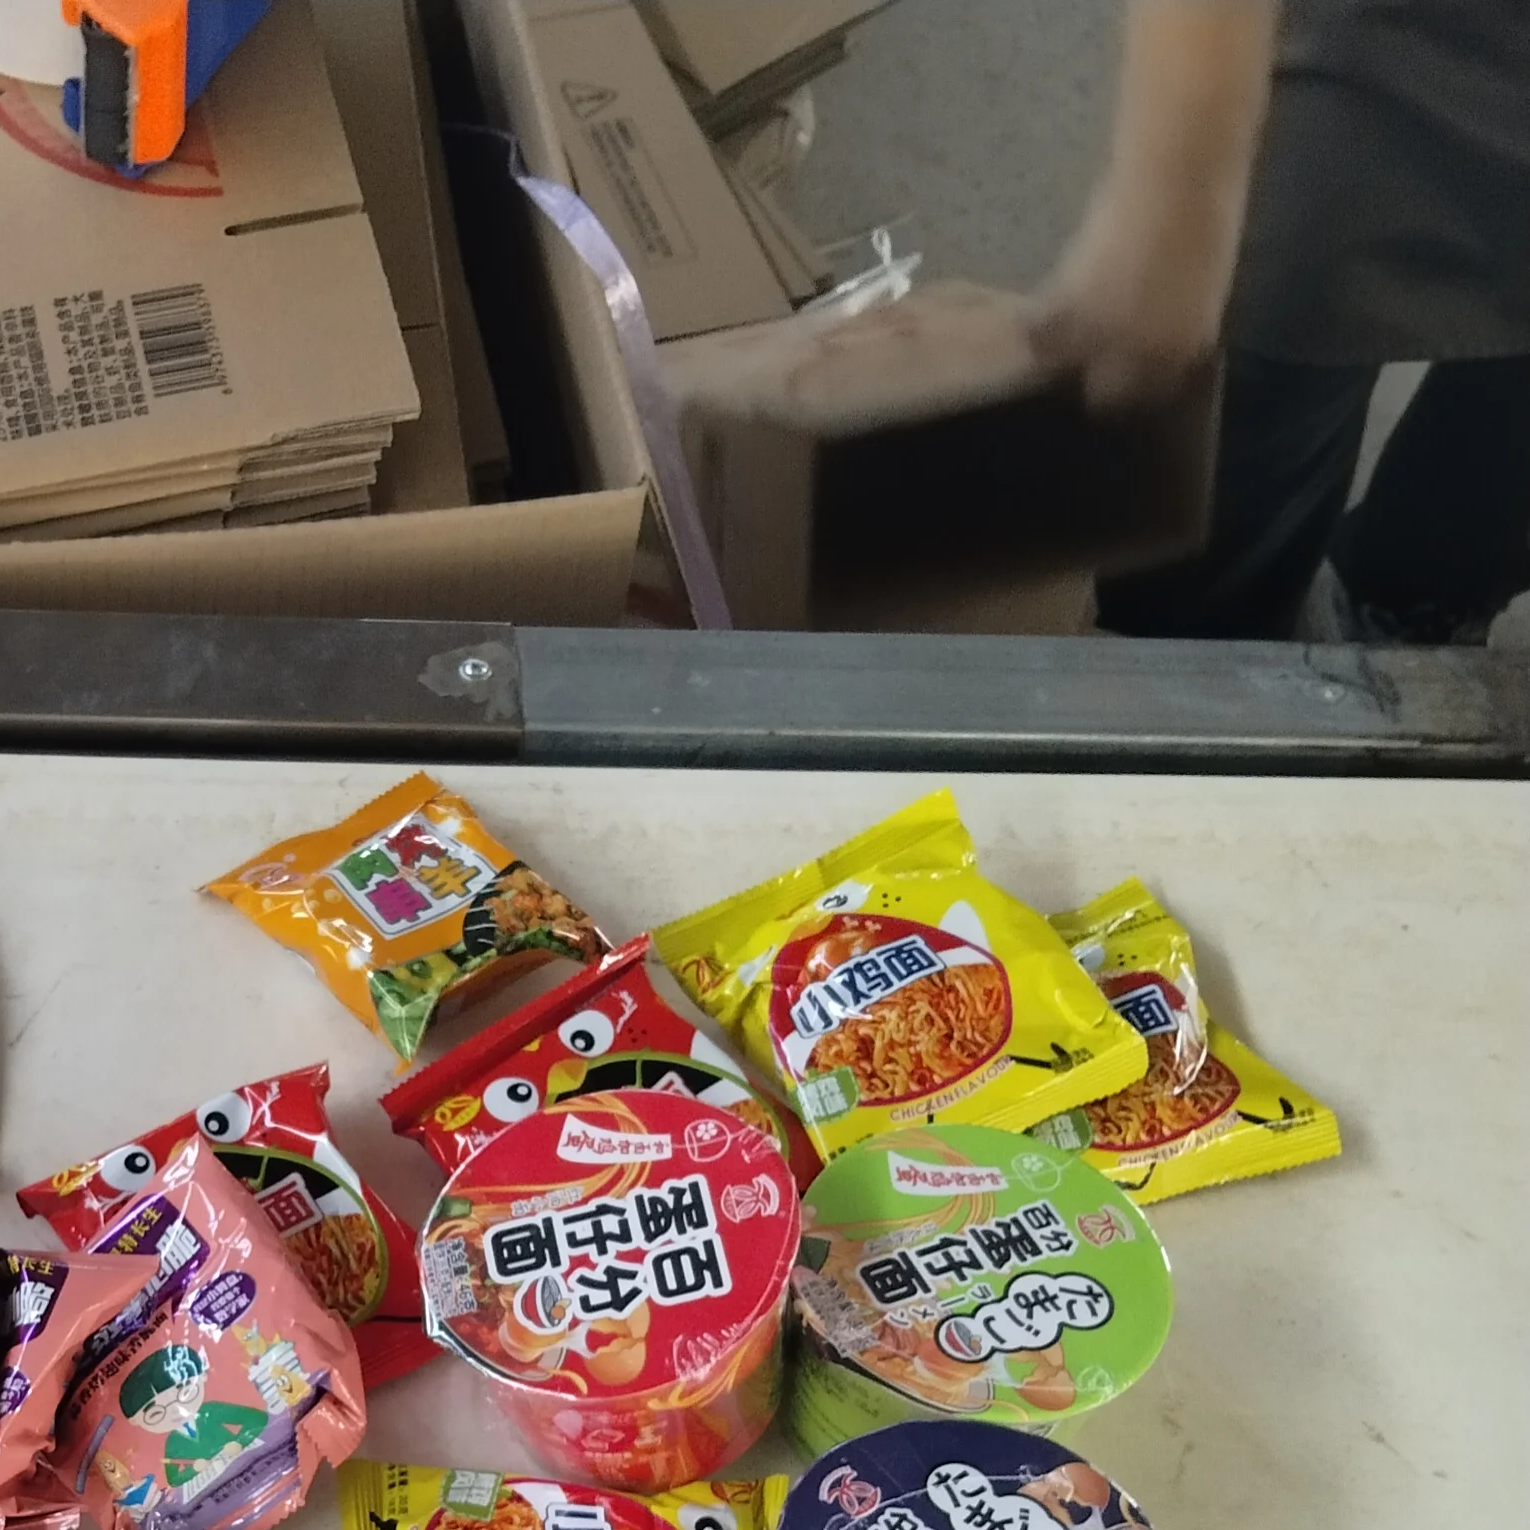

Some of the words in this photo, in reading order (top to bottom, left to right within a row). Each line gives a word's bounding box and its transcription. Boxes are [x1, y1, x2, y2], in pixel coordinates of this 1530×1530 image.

[794, 940, 939, 1036] 小鸡面
[490, 1180, 711, 1278] 蛋仔面
[860, 1220, 1044, 1304] 蛋仔面
[1022, 1202, 1075, 1257] 百分
[212, 1292, 251, 1322] 数学家
[580, 1237, 724, 1313] 百分
[886, 1284, 995, 1327] ラーメン
[978, 1283, 1100, 1345] たまご
